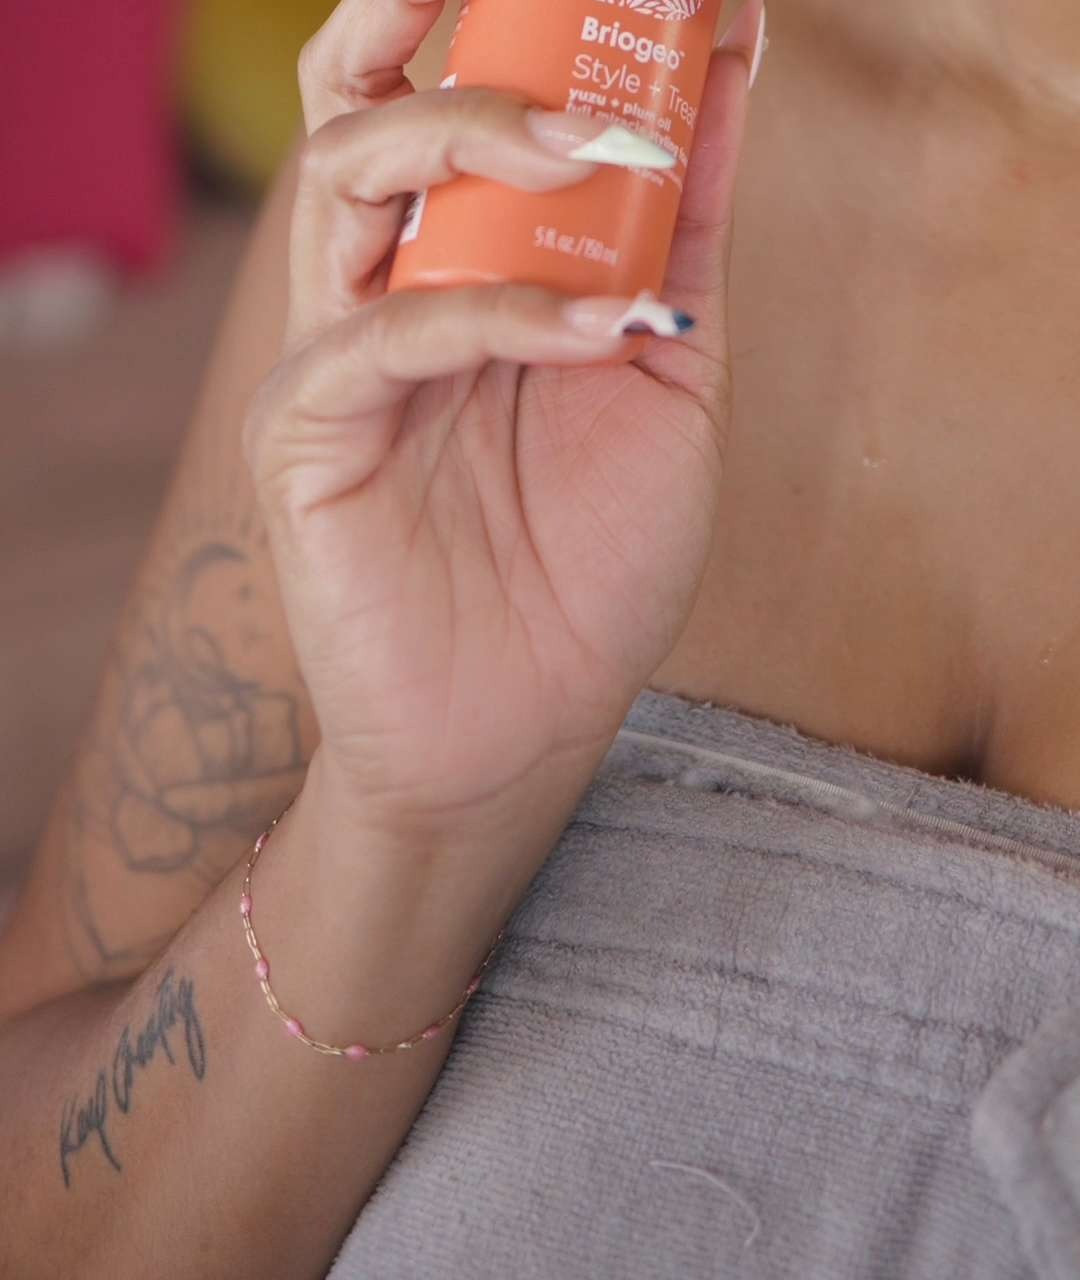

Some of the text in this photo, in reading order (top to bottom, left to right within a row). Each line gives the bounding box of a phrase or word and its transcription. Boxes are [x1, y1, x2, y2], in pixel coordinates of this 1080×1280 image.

[571, 53, 641, 94] Style
[649, 80, 662, 98] +
[568, 87, 607, 107] yuzu
[621, 101, 657, 123] plum
[657, 117, 673, 133] oil
